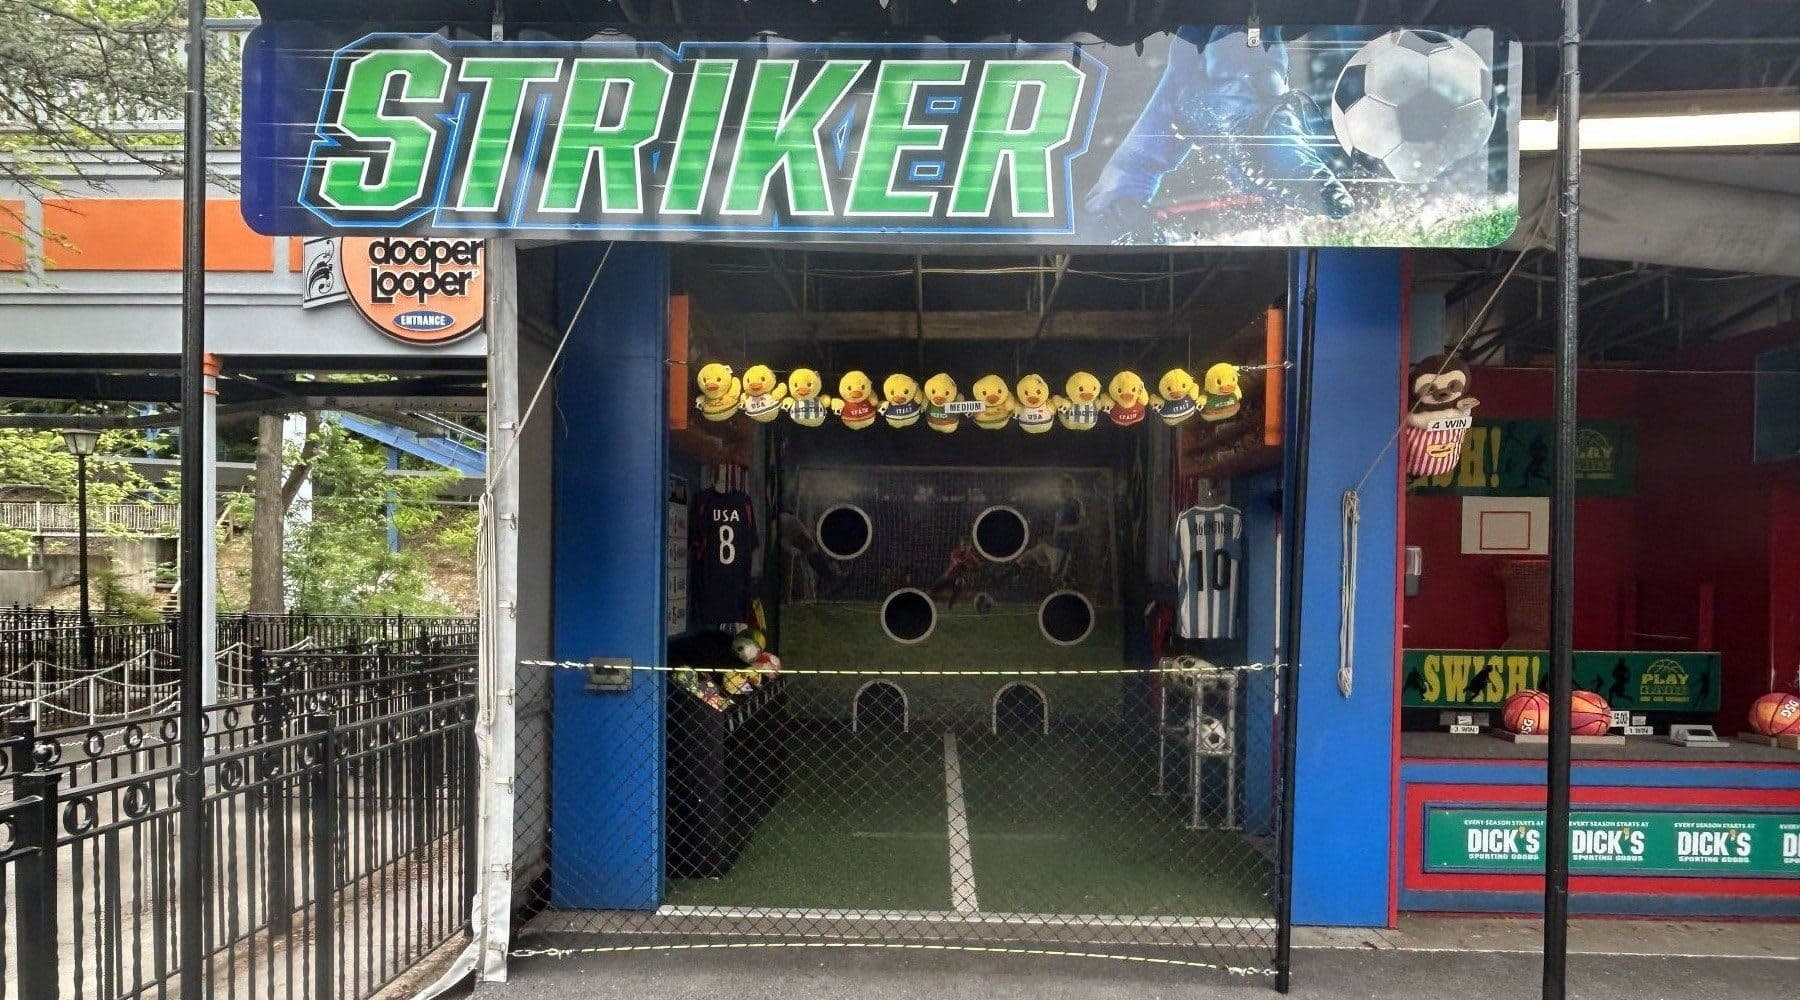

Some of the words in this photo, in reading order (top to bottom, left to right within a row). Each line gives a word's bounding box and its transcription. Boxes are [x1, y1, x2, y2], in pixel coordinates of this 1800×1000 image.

[318, 48, 1082, 217] STRIKER
[368, 236, 484, 272] dooper
[400, 315, 446, 326] ENTRANCE
[949, 402, 982, 412] MEDIUM
[1432, 421, 1440, 429] 4
[1445, 419, 1467, 429] WIN
[713, 509, 740, 522] USA
[718, 524, 736, 565] 8
[1189, 548, 1231, 591] 10
[1641, 673, 1689, 685] PLAY
[1467, 826, 1541, 854] DICK'S
[1571, 827, 1645, 855] DICK'S
[1677, 829, 1752, 857] DICK'S
